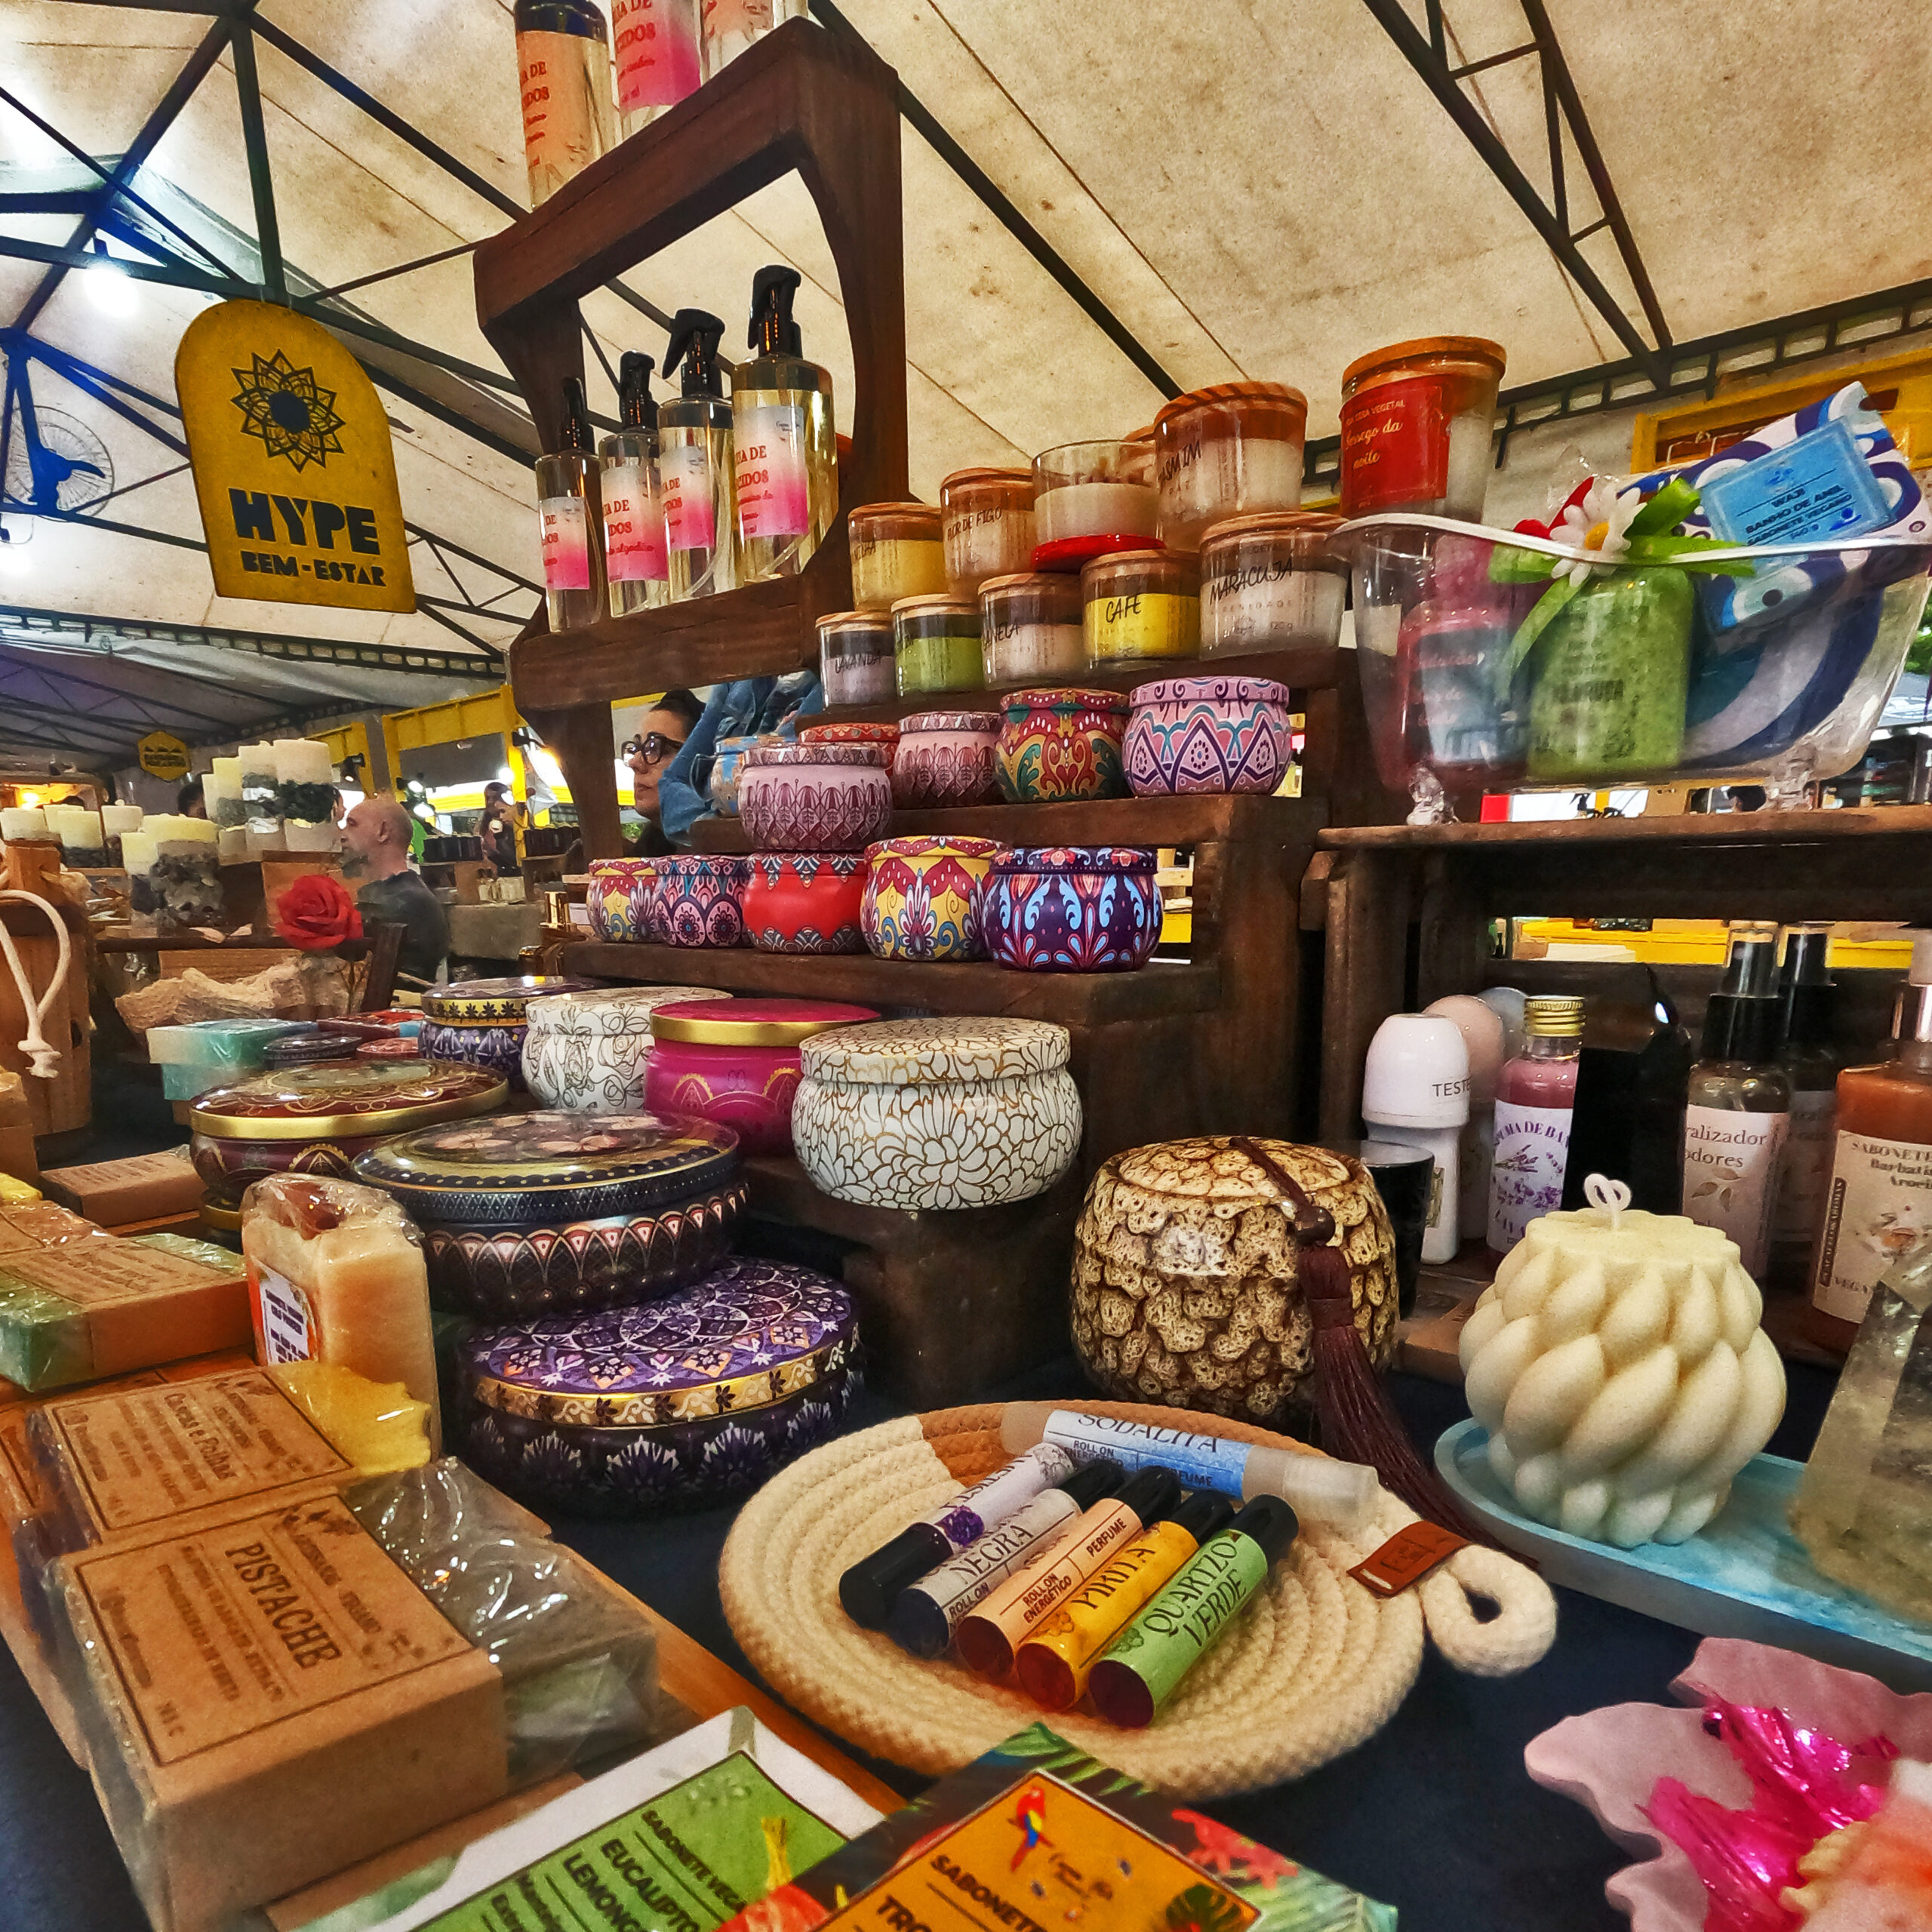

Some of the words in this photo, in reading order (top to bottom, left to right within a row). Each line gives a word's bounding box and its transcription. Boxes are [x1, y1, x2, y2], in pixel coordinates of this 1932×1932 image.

[529, 61, 547, 77] DE
[1371, 399, 1406, 414] VEGETAL
[1382, 417, 1404, 434] da
[749, 445, 767, 460] DE
[668, 477, 681, 491] DE
[229, 488, 380, 555] HYPE
[545, 514, 556, 526] DE
[613, 499, 630, 514] DE
[975, 506, 1004, 528] FIGO
[1745, 509, 1792, 534] BANHO
[1793, 497, 1811, 512] DE
[1746, 516, 1804, 546] SABONETE
[1804, 493, 1853, 519] VEGANO
[241, 550, 386, 587] BEM-ESTAR
[835, 649, 882, 674] LAVANDA
[1524, 1120, 1544, 1136] DE
[1851, 1140, 1932, 1163] SABONETE
[1073, 1440, 1099, 1455] ROLL
[1099, 1445, 1115, 1458] ON
[1078, 1413, 1218, 1454] SODALITA
[949, 1524, 1035, 1586] NEGRA
[1022, 1583, 1046, 1607] ROLL
[1041, 1573, 1060, 1592] ON
[1085, 1517, 1128, 1558] PERFUME
[224, 1540, 344, 1671] PISTACHE
[948, 1595, 974, 1620] ROLL
[973, 1581, 992, 1601] ON
[1143, 1540, 1238, 1638] QUARTZO
[1182, 1567, 1247, 1648] VERDE
[641, 1809, 712, 1883] SABONETE
[600, 1837, 702, 1932] EUCALIPTO
